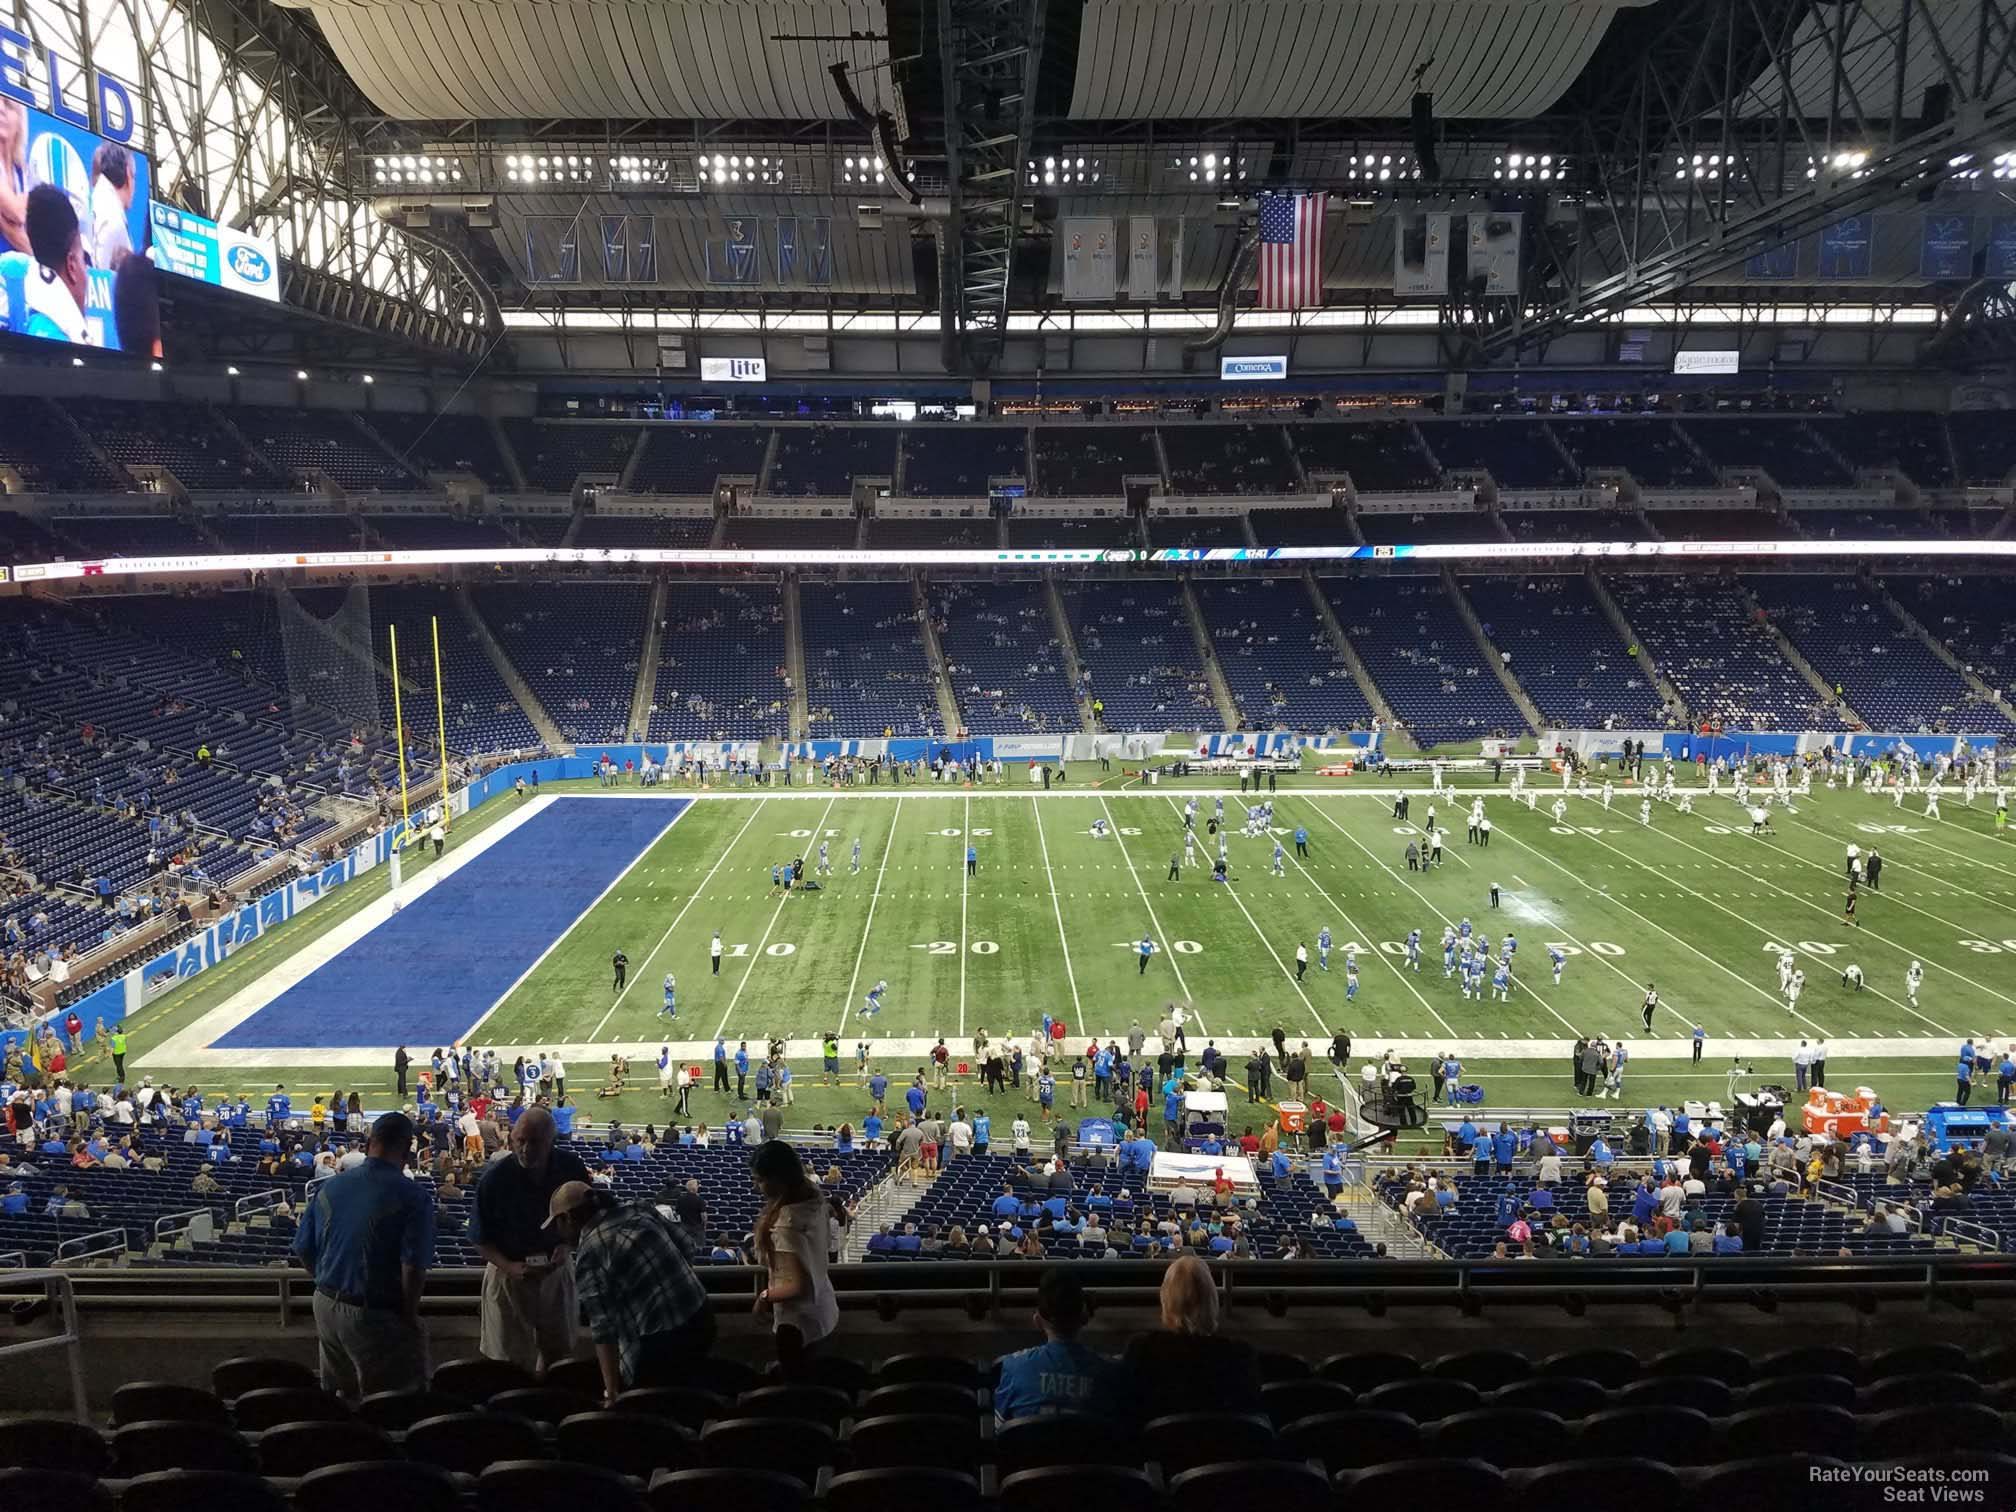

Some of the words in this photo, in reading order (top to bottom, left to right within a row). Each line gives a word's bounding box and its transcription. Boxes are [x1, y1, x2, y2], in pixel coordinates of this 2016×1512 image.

[234, 247, 265, 281] Ford
[730, 359, 760, 379] Lite
[725, 942, 796, 957] 10
[928, 941, 1000, 955] 20
[691, 1067, 700, 1077] 10
[958, 1064, 968, 1073] 20
[220, 1111, 230, 1120] 20
[729, 1130, 737, 1141] 4
[1735, 1157, 1744, 1168] 15
[1506, 1203, 1512, 1214] 9
